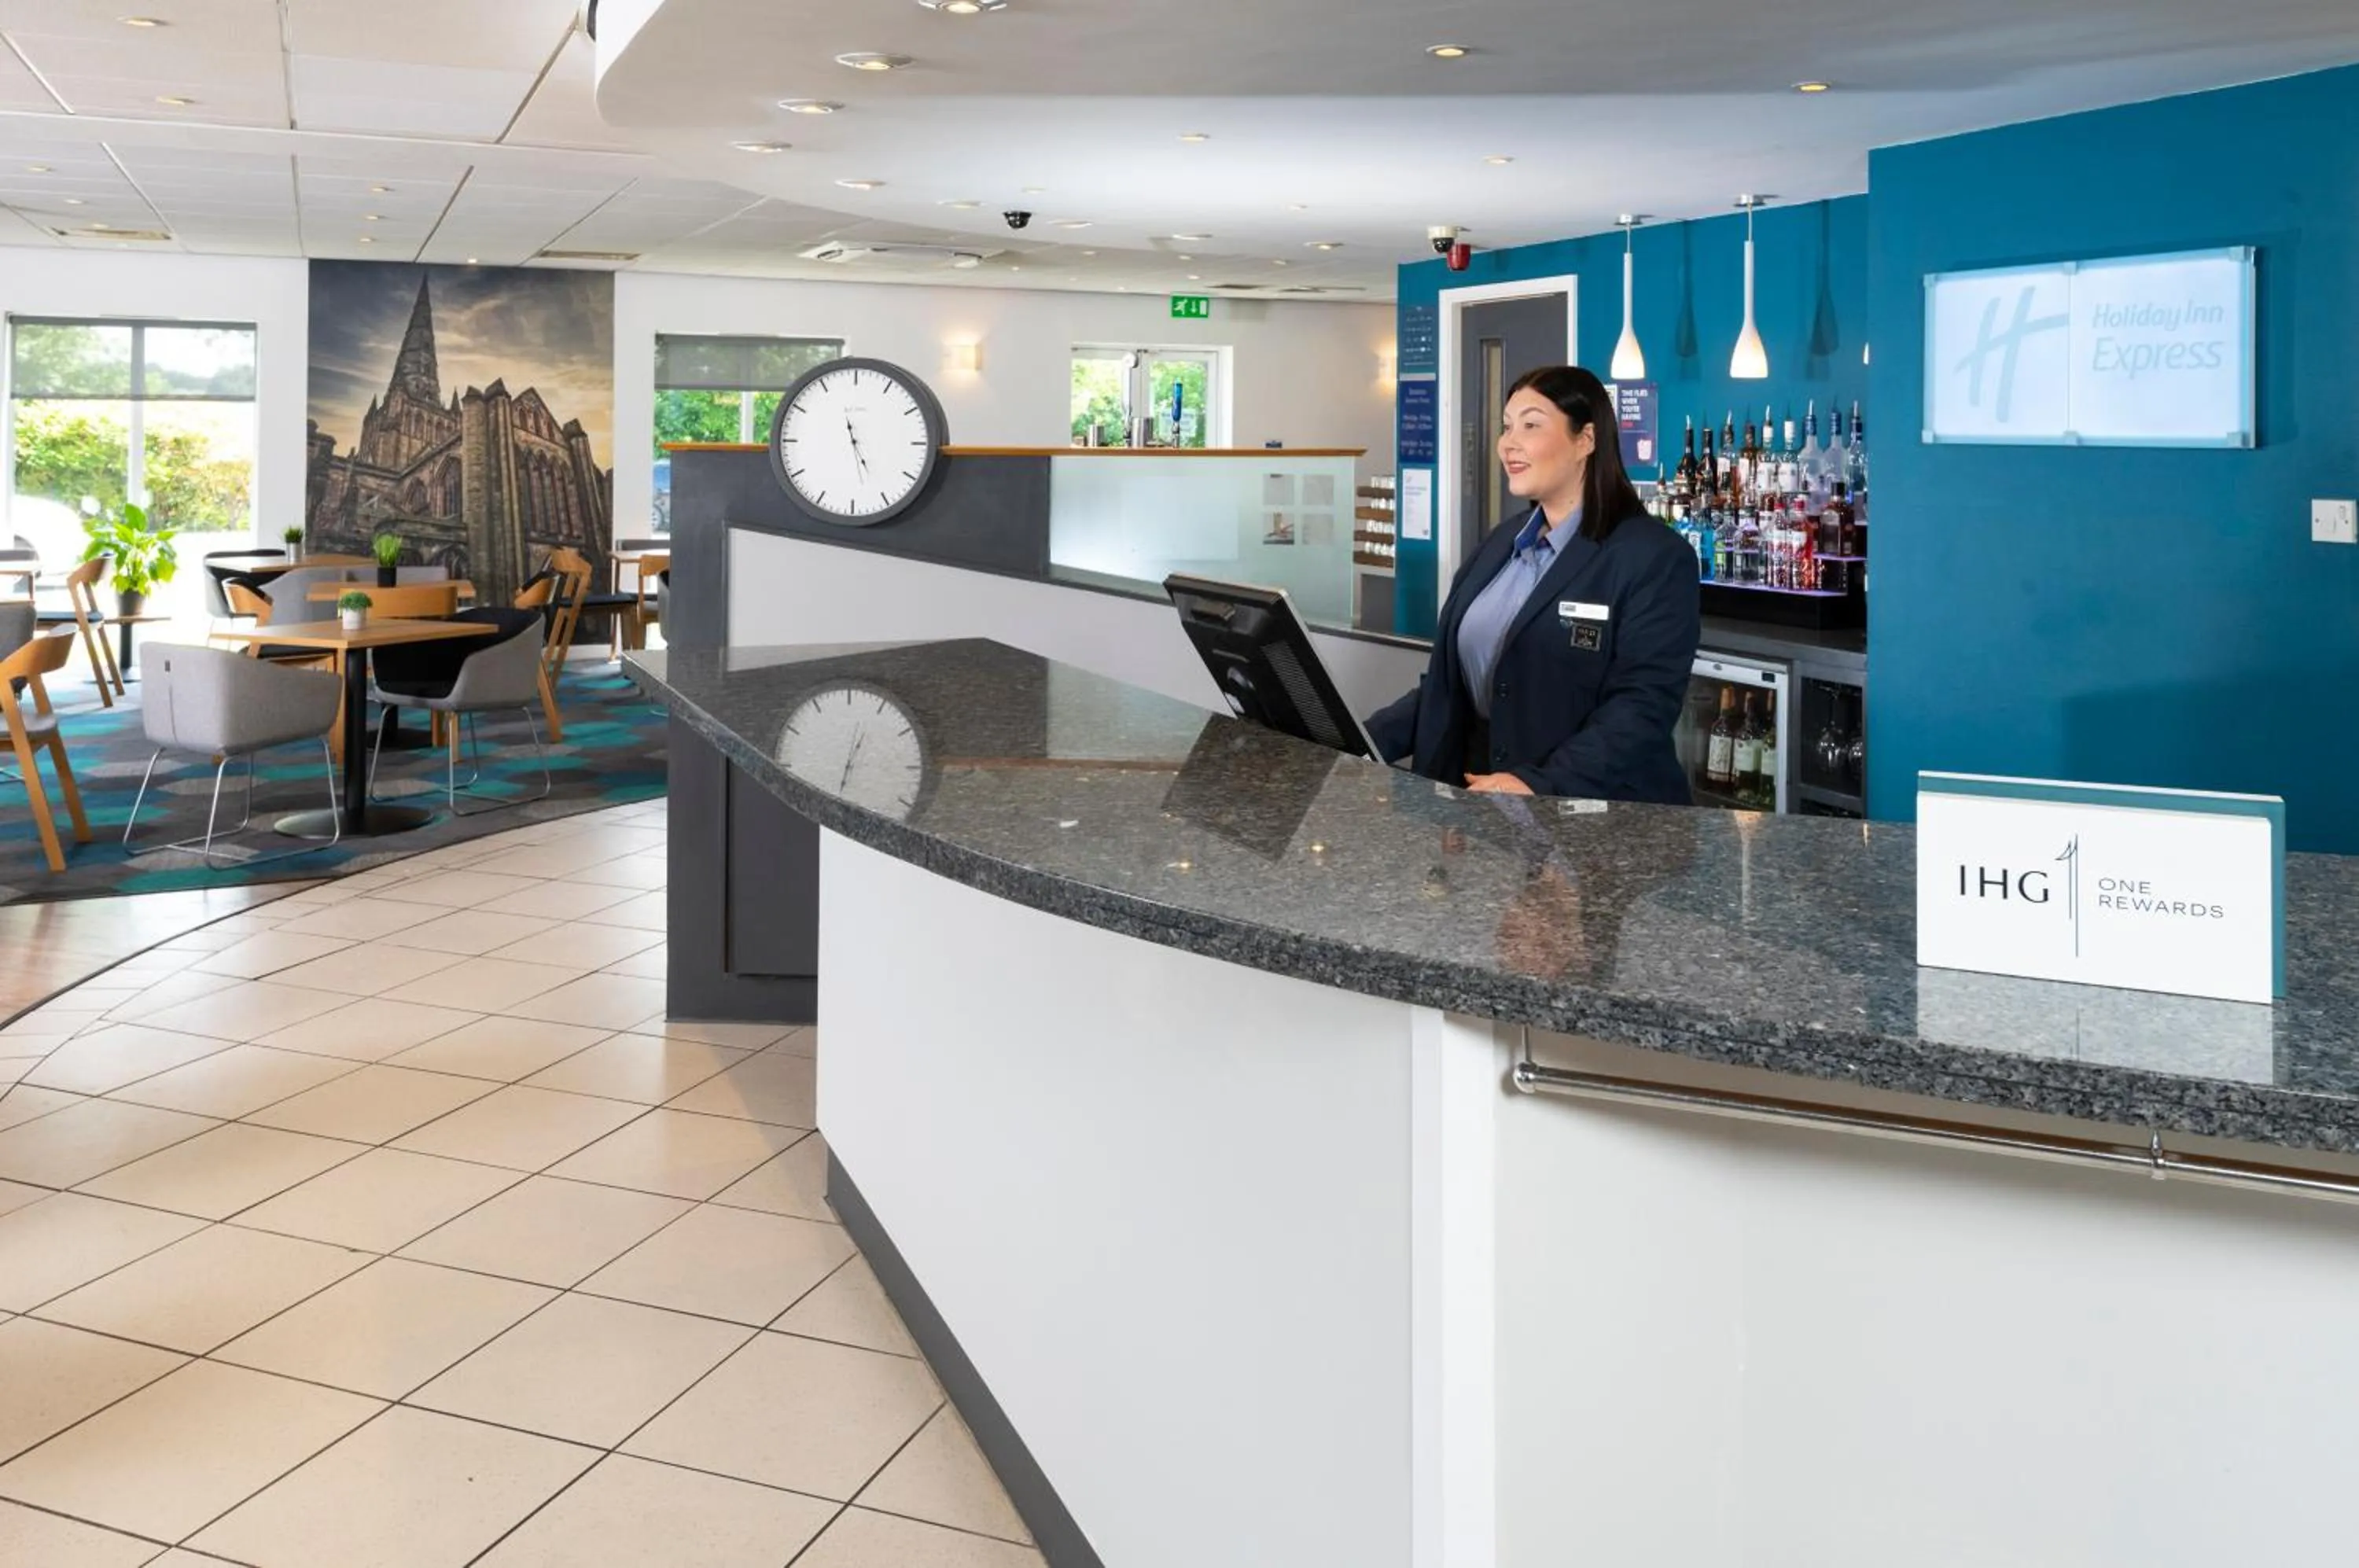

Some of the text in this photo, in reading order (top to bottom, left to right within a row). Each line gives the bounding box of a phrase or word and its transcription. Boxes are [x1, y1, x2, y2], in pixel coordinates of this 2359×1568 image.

[2092, 299, 2225, 331] Holiday Inn
[2092, 337, 2225, 380] Express
[1960, 864, 2048, 904] IHG
[2099, 878, 2151, 894] ONE
[2099, 894, 2225, 919] REWARDS
